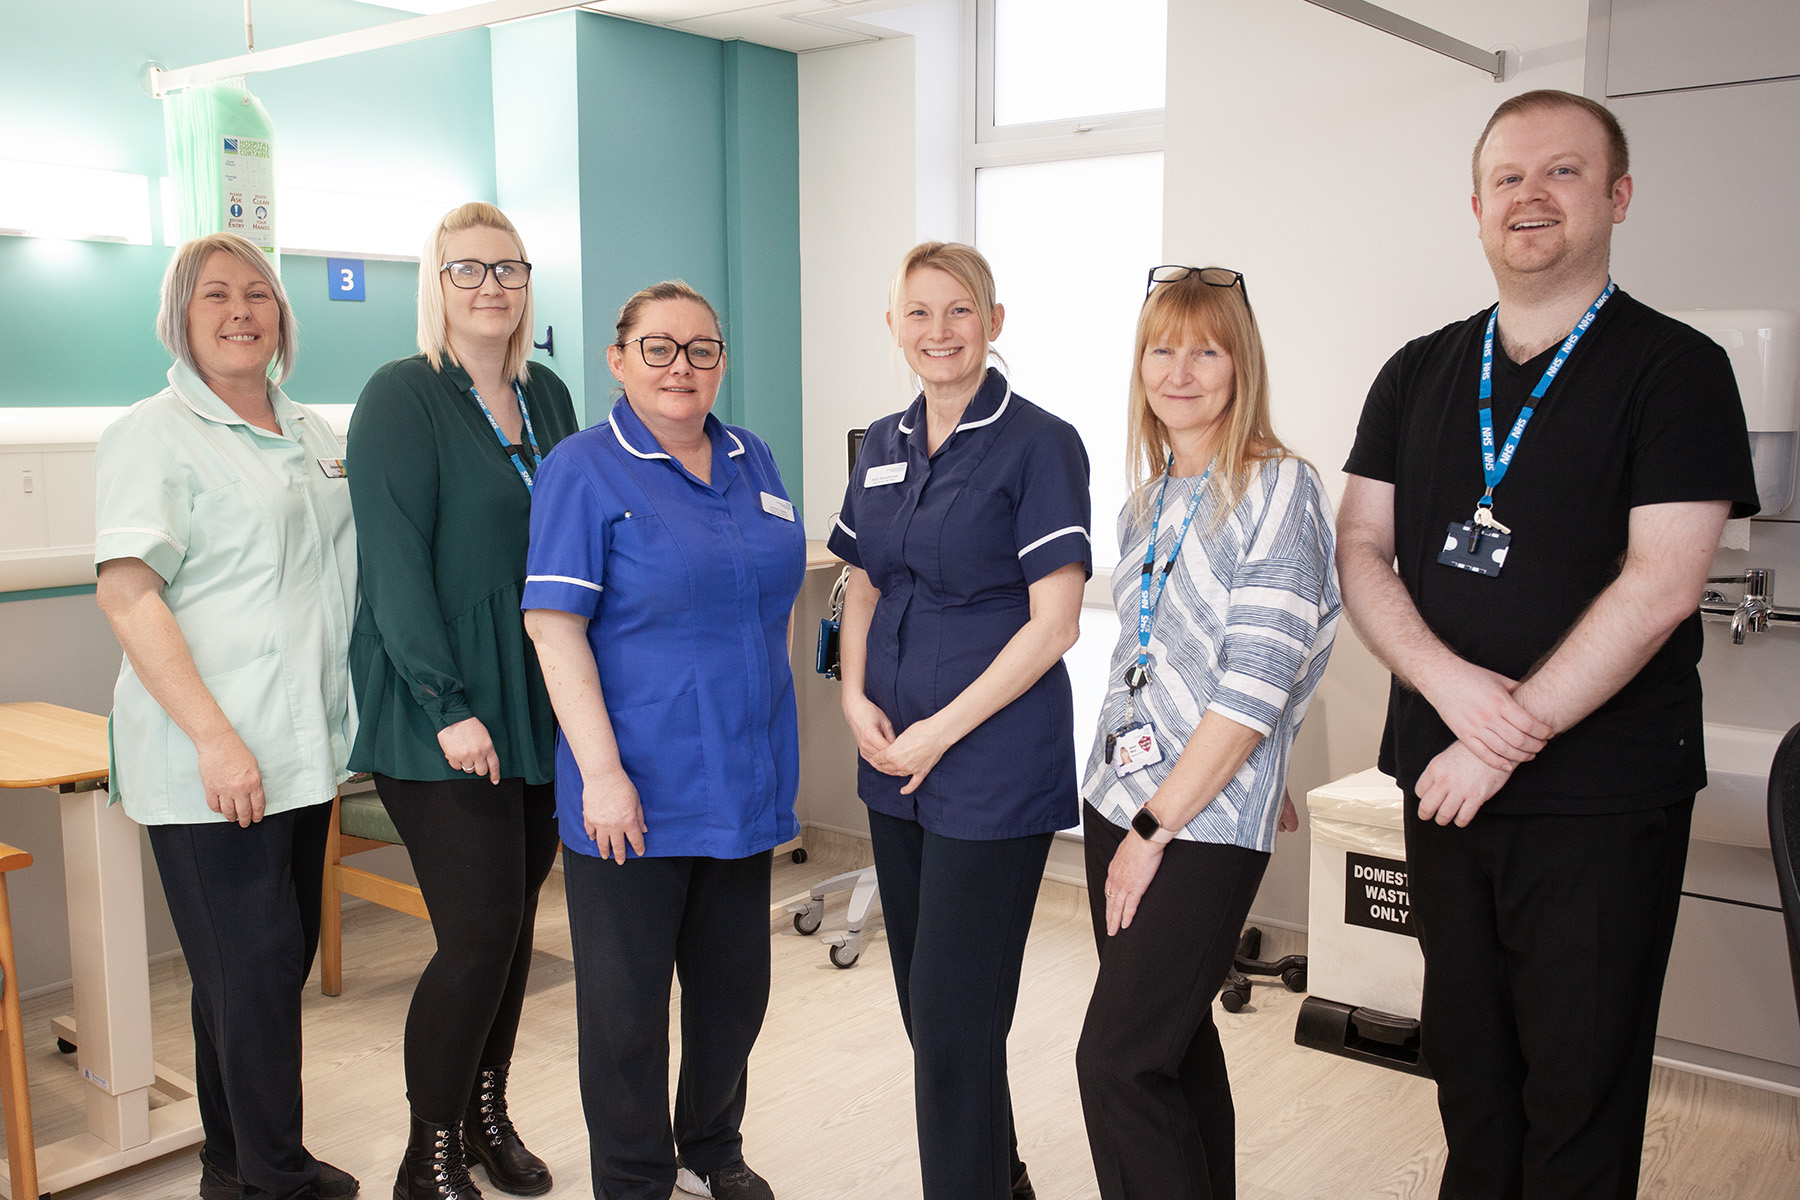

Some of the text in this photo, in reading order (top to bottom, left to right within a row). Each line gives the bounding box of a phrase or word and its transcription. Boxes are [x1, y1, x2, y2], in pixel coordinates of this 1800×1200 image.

[239, 139, 270, 151] HOSPITAL
[239, 150, 270, 159] CURTAINS
[253, 197, 269, 205] CLEAN
[228, 221, 244, 229] ENTRY
[253, 223, 270, 231] HANDS
[340, 268, 354, 292] 3
[1486, 316, 1496, 335] NHS
[1484, 338, 1492, 358] NHS
[1482, 361, 1491, 381] NHS
[1500, 291, 1609, 466] NHS NHS NHS NHS NHS NHS
[474, 394, 533, 486] NHS NHS NHS
[1482, 426, 1493, 447] NHS
[1484, 452, 1495, 472] NHS
[1185, 500, 1198, 520] NHS
[1141, 589, 1150, 610] NHS
[1370, 904, 1410, 925] ONLY
